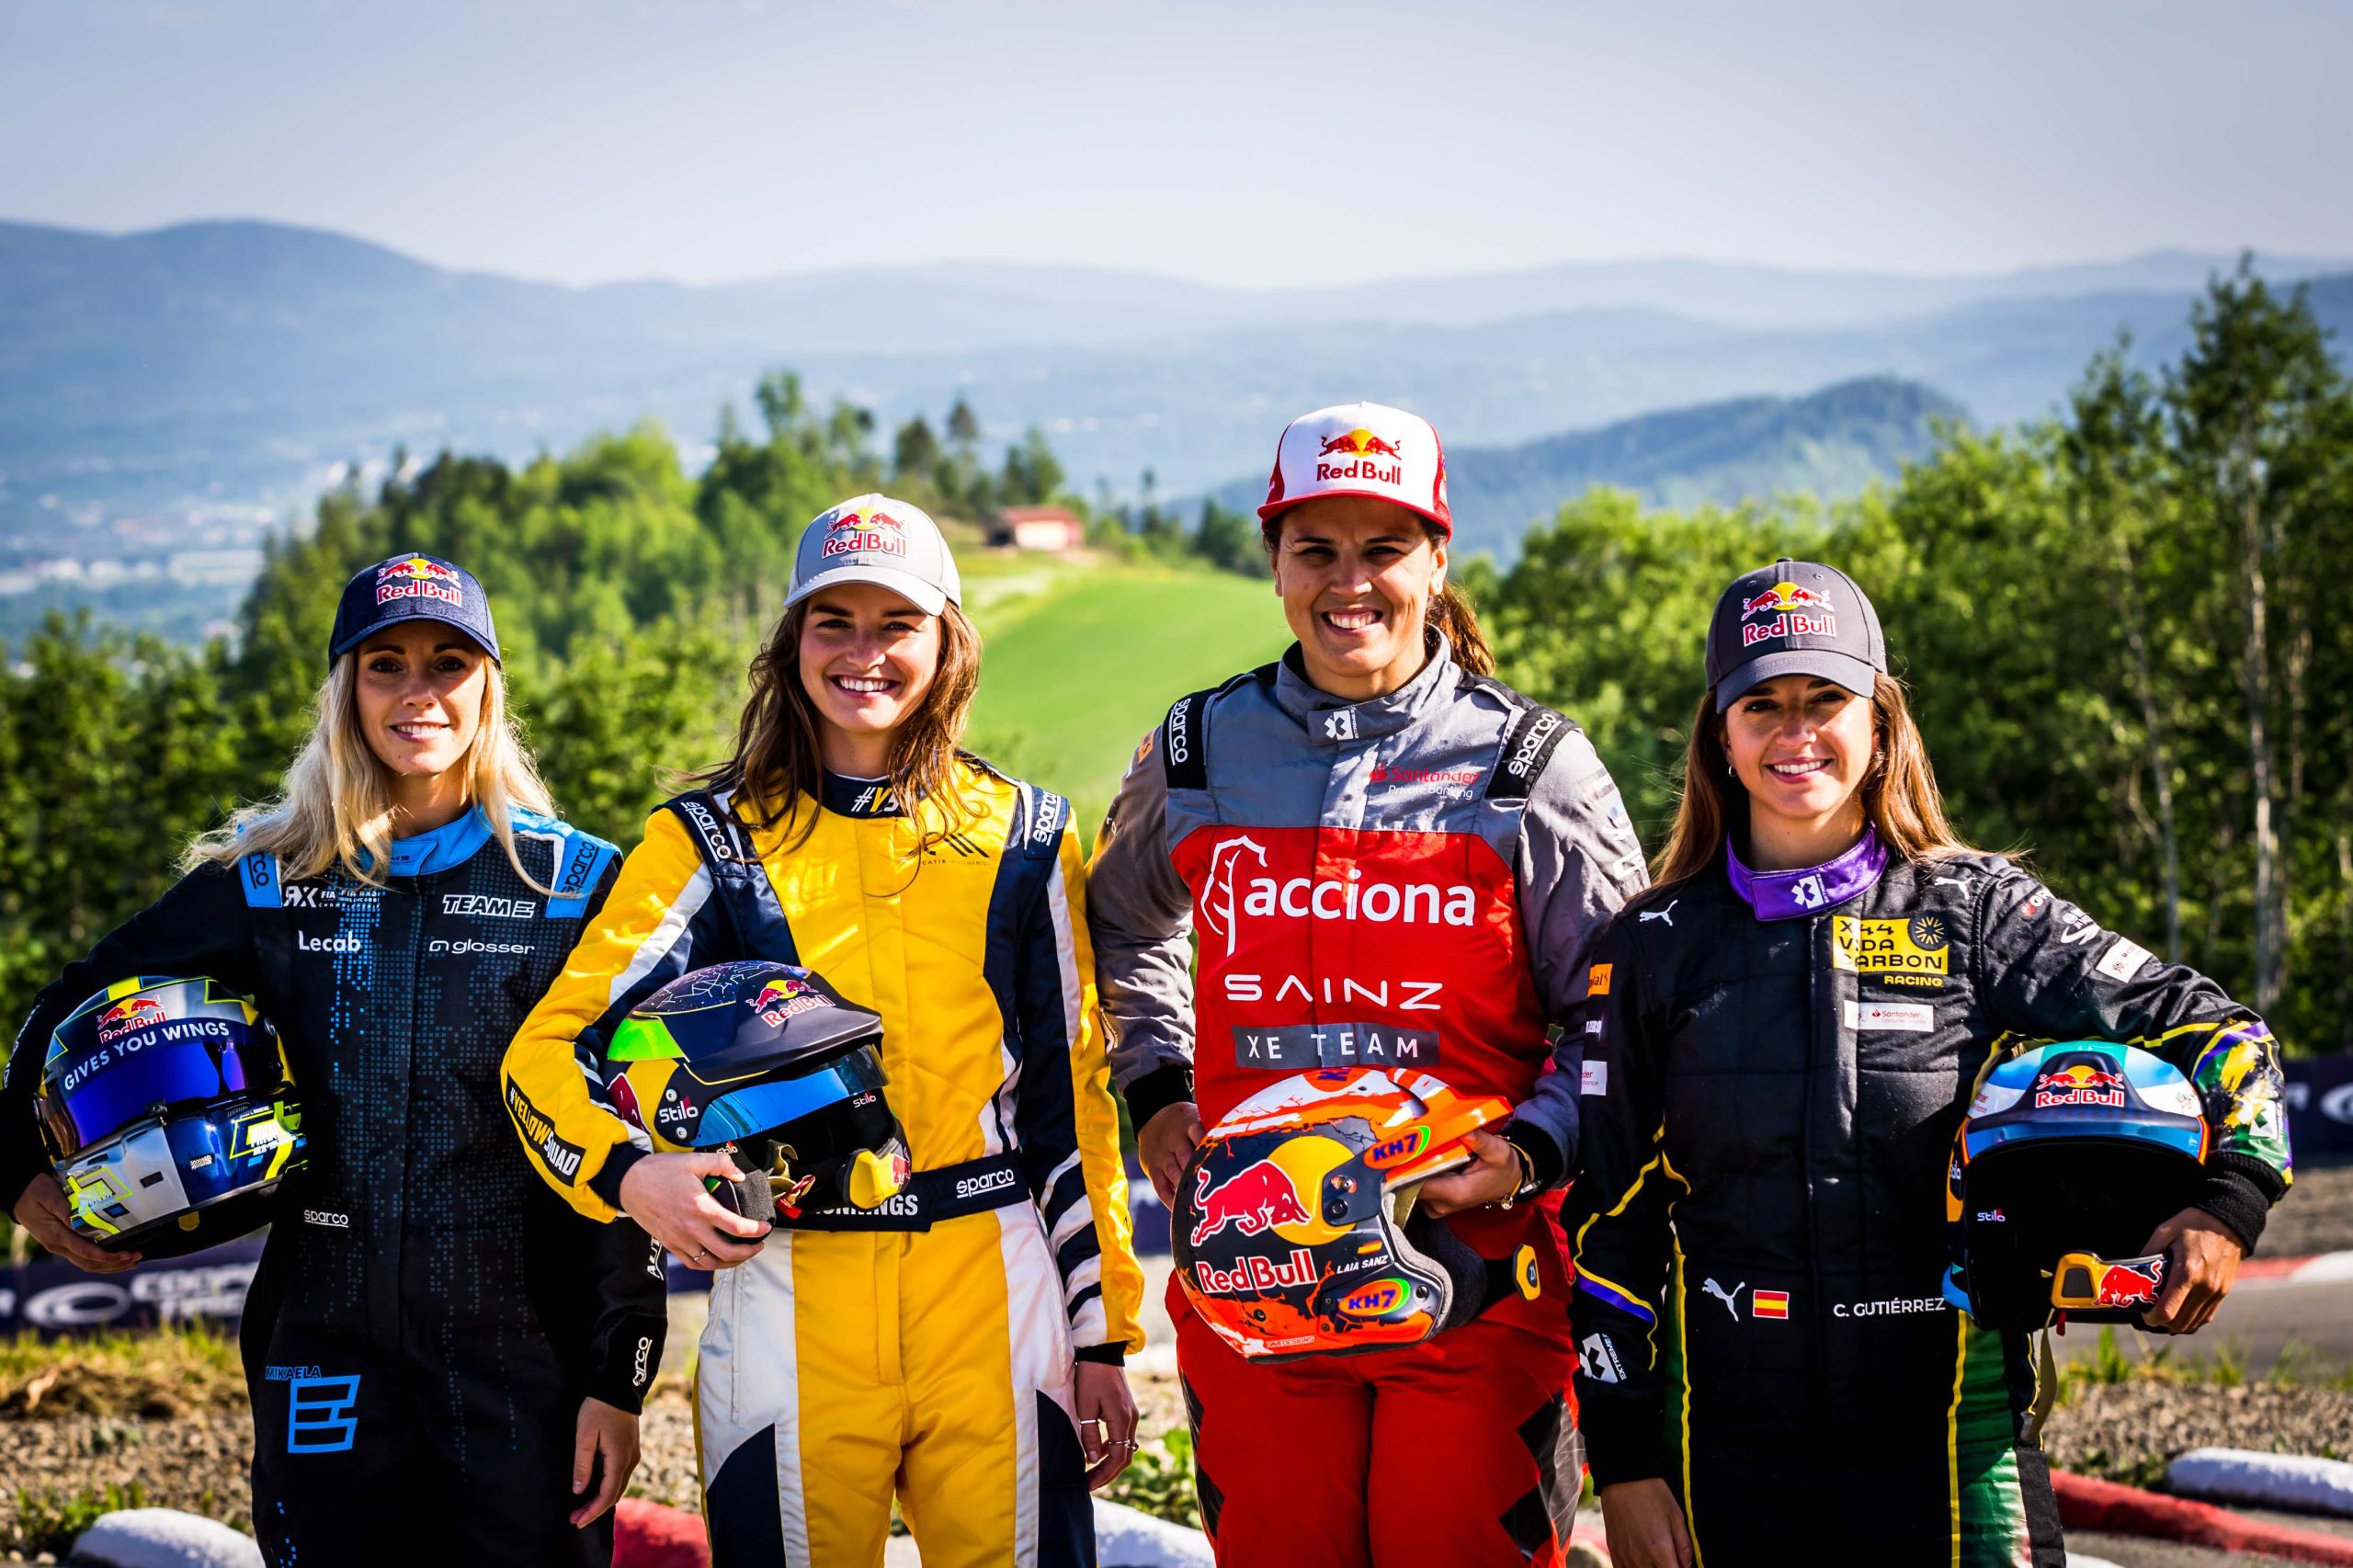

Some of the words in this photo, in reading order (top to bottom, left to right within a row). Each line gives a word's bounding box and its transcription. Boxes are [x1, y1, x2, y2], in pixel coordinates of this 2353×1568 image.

[1316, 460, 1358, 482] Red
[1362, 460, 1402, 485] Bull
[822, 531, 863, 559] Red
[866, 533, 906, 558] Bull
[377, 579, 421, 605] Red
[422, 580, 461, 607] Bull
[1743, 613, 1788, 647] Red
[1790, 613, 1836, 638] Bull
[1168, 698, 1192, 767] sparco
[1507, 713, 1563, 778] sparco
[1391, 766, 1480, 785] Santander
[1388, 785, 1425, 796] Private
[1428, 785, 1473, 801] Banking
[1031, 790, 1061, 846] sparc
[680, 801, 732, 862] sparco
[1244, 868, 1476, 926] acciona
[298, 930, 361, 952] Lecab
[451, 938, 535, 954] glosser
[1842, 953, 1942, 970] ARBON
[1224, 974, 1443, 1010] SAINZ
[1884, 975, 1943, 987] RACING
[761, 997, 806, 1028] Red
[796, 994, 836, 1014] Bull
[99, 1018, 132, 1043] Red
[133, 1011, 168, 1030] Bull
[64, 1050, 110, 1091] GIVES
[113, 1030, 158, 1057] YOU
[161, 1021, 230, 1040] WINGS
[1247, 1035, 1283, 1059] XE
[1310, 1031, 1419, 1059] TEAM
[853, 1092, 877, 1108] Stilo
[2035, 1089, 2078, 1108] Red
[2081, 1089, 2125, 1108] Bull
[659, 1100, 699, 1124] Stilo
[1373, 1132, 1417, 1162] KH7
[956, 1168, 1016, 1199] sparco
[304, 1209, 349, 1228] sparco
[1977, 1209, 2006, 1221] Stilo
[1196, 1256, 1251, 1293] Red
[1248, 1248, 1318, 1289] Bull
[1336, 1263, 1359, 1275] LAIA
[1361, 1255, 1389, 1270] SANZ
[1347, 1289, 1396, 1311] KH7
[1833, 1303, 1849, 1317] C.
[1853, 1297, 1946, 1317] GUTIÉRREZ
[265, 1366, 322, 1381] MIKAELA
